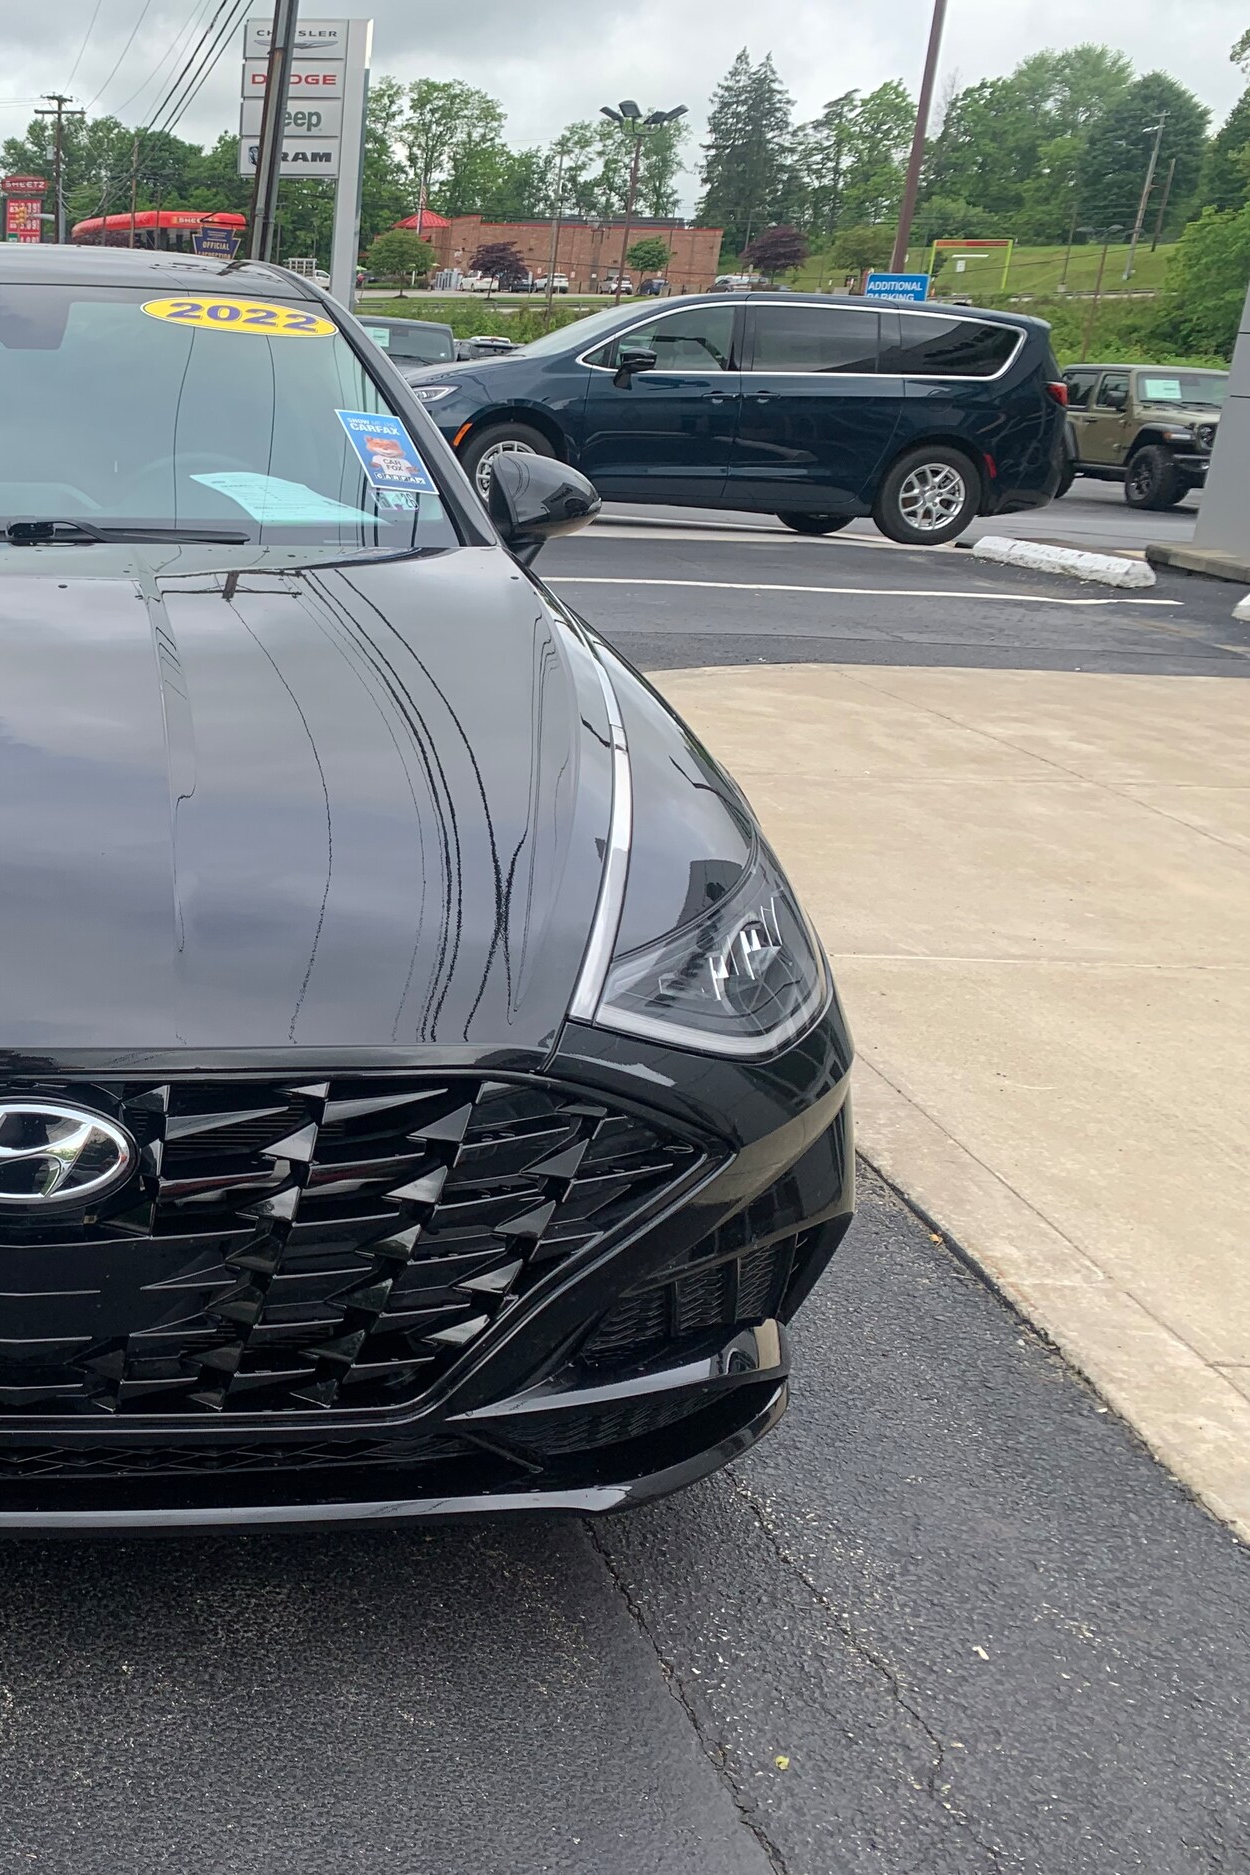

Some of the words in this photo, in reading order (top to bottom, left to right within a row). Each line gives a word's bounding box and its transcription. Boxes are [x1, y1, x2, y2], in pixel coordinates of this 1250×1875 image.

[252, 74, 336, 85] DDGE
[283, 110, 322, 132] eep
[202, 241, 230, 250] OFFICIAL
[868, 281, 923, 290] ADDITIONAL
[166, 302, 318, 333] 2022
[350, 422, 401, 436] CARFAX
[383, 458, 401, 466] CAR
[374, 472, 426, 485] CARFAX
